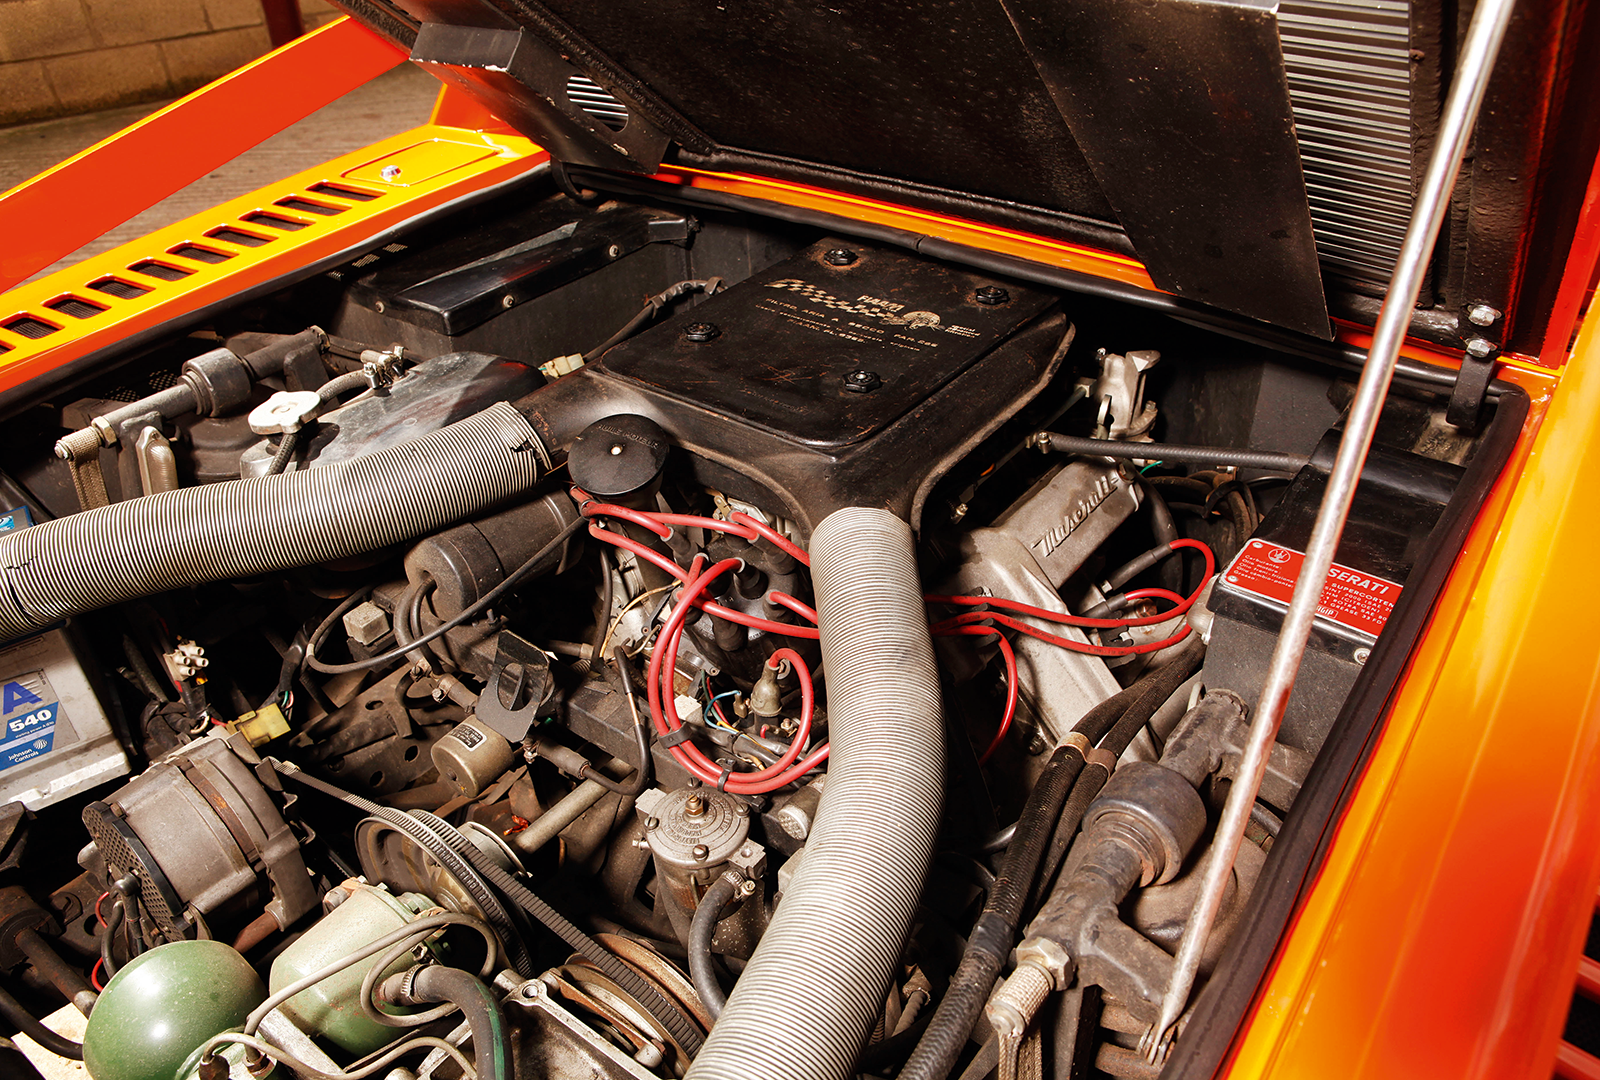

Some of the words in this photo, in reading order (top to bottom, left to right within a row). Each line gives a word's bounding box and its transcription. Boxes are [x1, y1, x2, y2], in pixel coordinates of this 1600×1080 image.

[765, 298, 798, 310] FILTRO
[801, 309, 825, 318] ARIA
[1327, 568, 1390, 595] SERATI
[1330, 602, 1359, 616] GREASE
[1333, 599, 1357, 610] ROTRA
[1360, 608, 1375, 617] SAE
[9, 709, 52, 732] 540
[8, 748, 33, 761] Johnson
[14, 751, 39, 763] Controls
